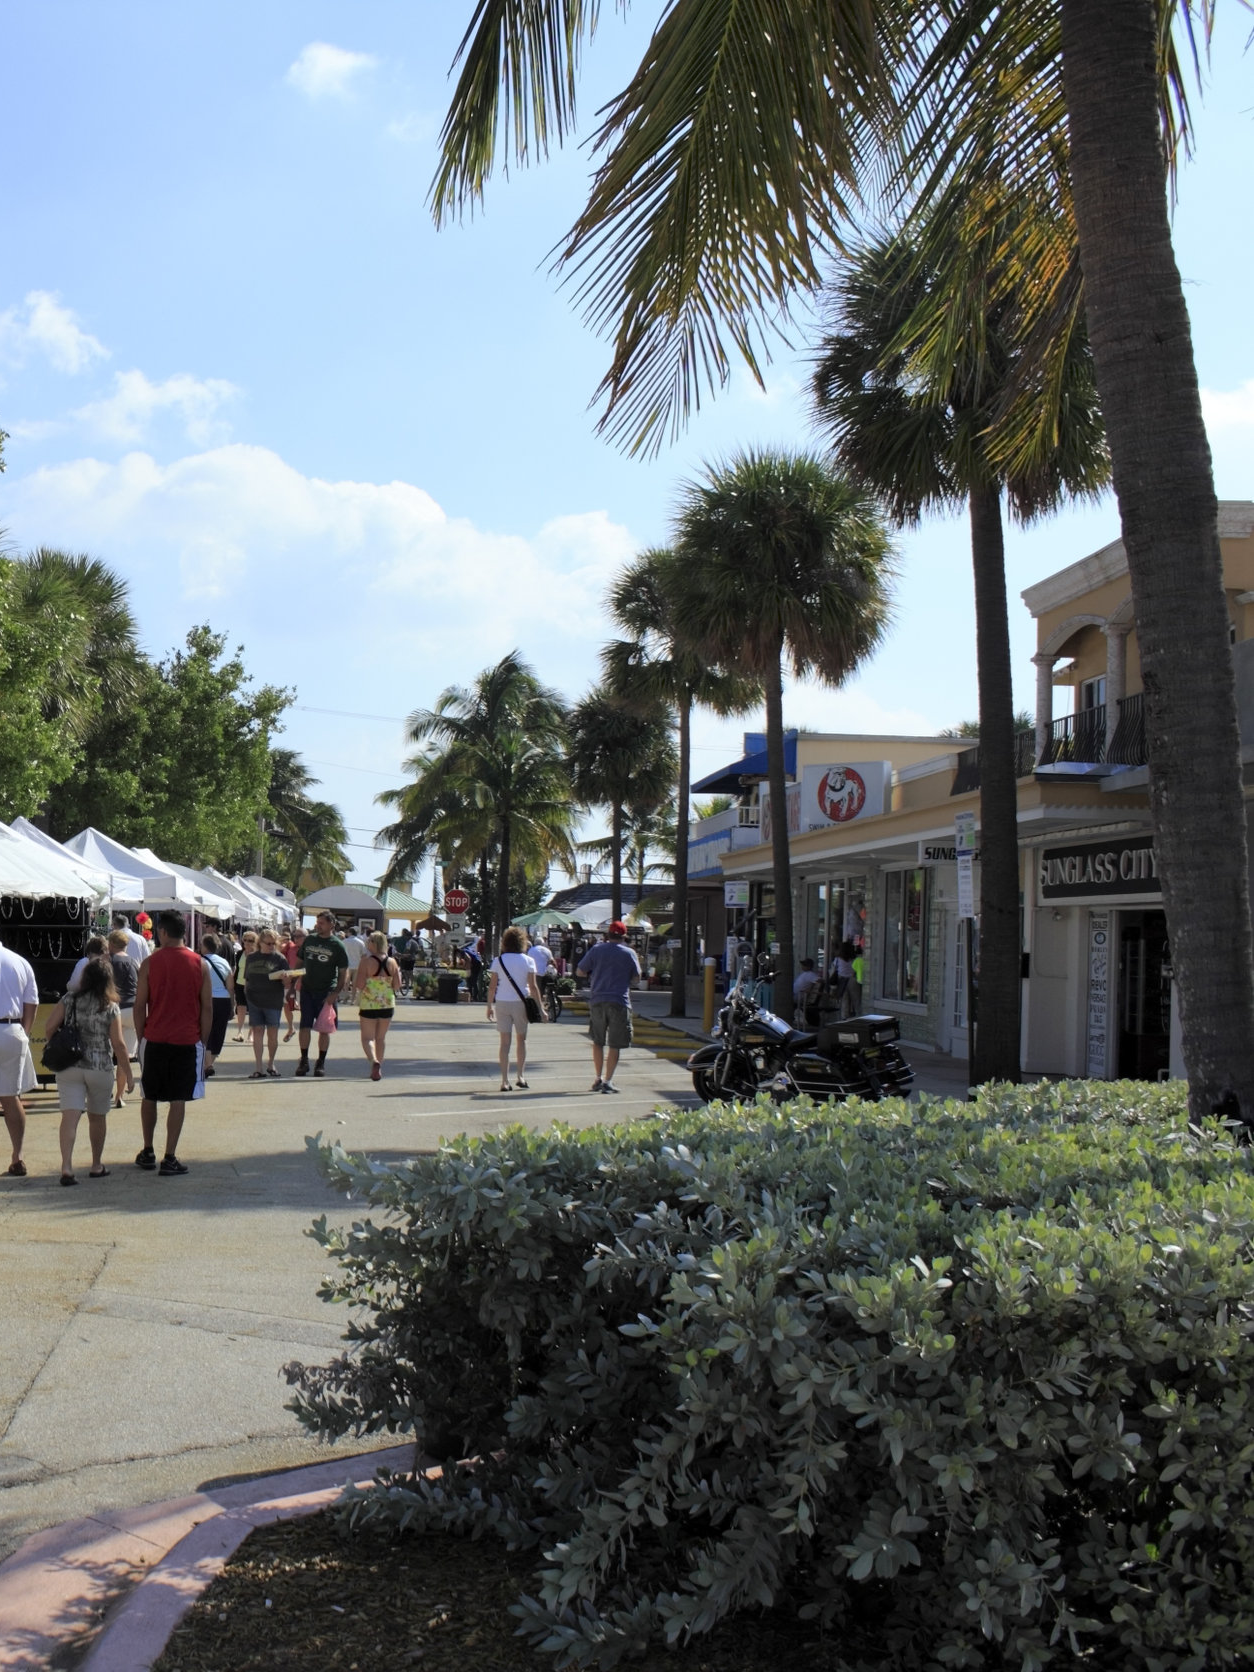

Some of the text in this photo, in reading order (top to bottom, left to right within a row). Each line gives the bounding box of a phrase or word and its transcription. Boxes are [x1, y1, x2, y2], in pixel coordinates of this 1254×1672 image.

[1041, 848, 1159, 887] SUNGLASS CITY
[445, 896, 468, 907] STOP
[452, 922, 460, 931] P
